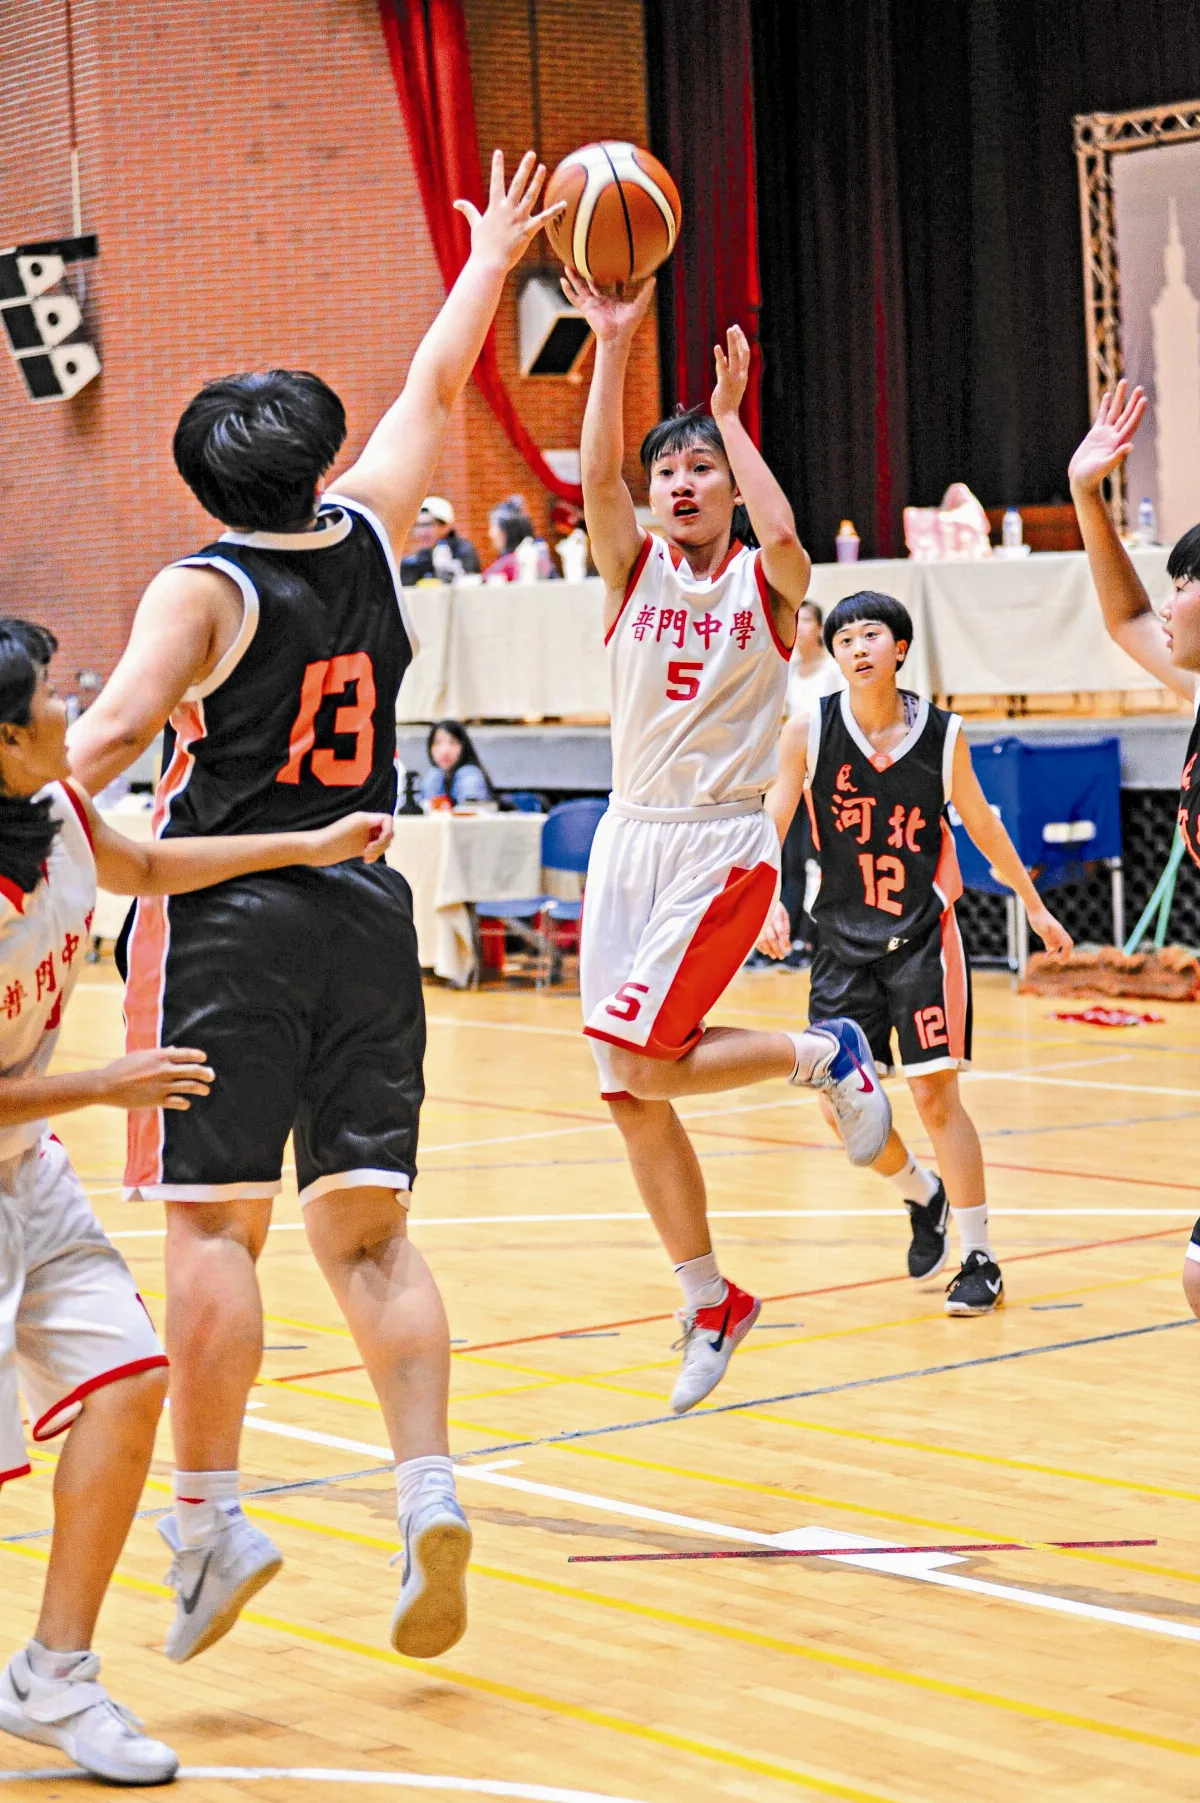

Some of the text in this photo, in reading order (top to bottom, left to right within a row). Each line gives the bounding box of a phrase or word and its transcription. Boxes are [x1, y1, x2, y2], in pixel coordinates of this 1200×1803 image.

[631, 604, 756, 651] 普門中學
[666, 661, 704, 701] 5
[275, 651, 376, 787] 13
[831, 794, 926, 852] 河北
[858, 853, 906, 916] 12
[605, 982, 650, 1022] 5
[913, 1005, 949, 1050] 12
